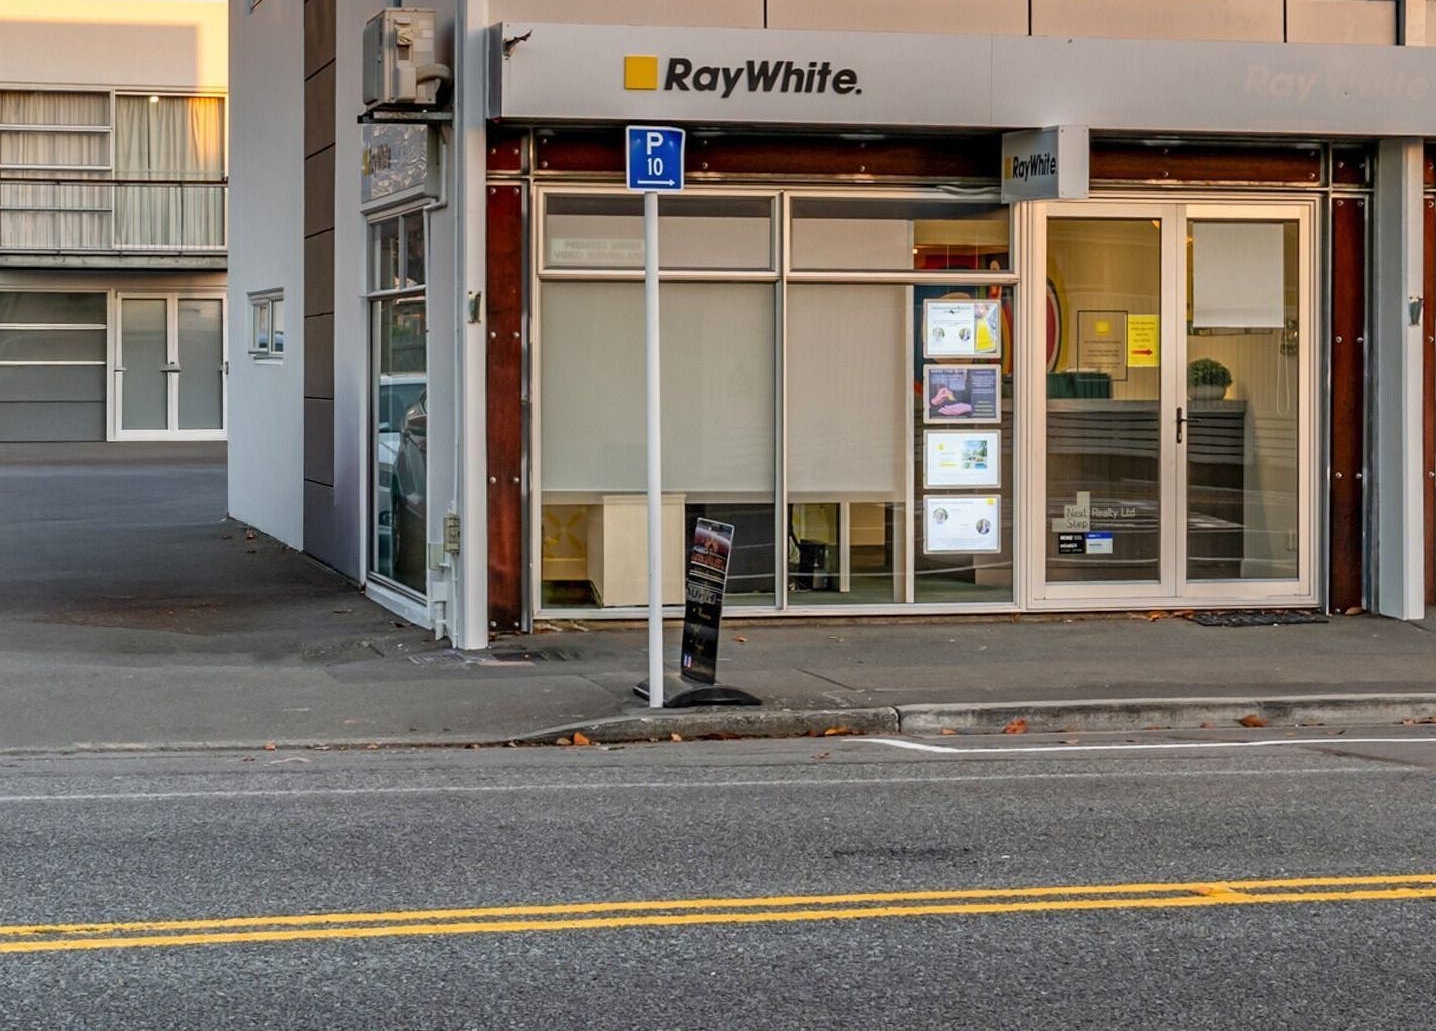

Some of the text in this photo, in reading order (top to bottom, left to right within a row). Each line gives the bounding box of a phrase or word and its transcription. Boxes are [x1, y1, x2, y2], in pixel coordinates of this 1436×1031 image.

[664, 57, 863, 99] RayWhite.
[646, 132, 664, 155] P
[647, 157, 663, 176] 10
[1121, 506, 1136, 517] Ltd
